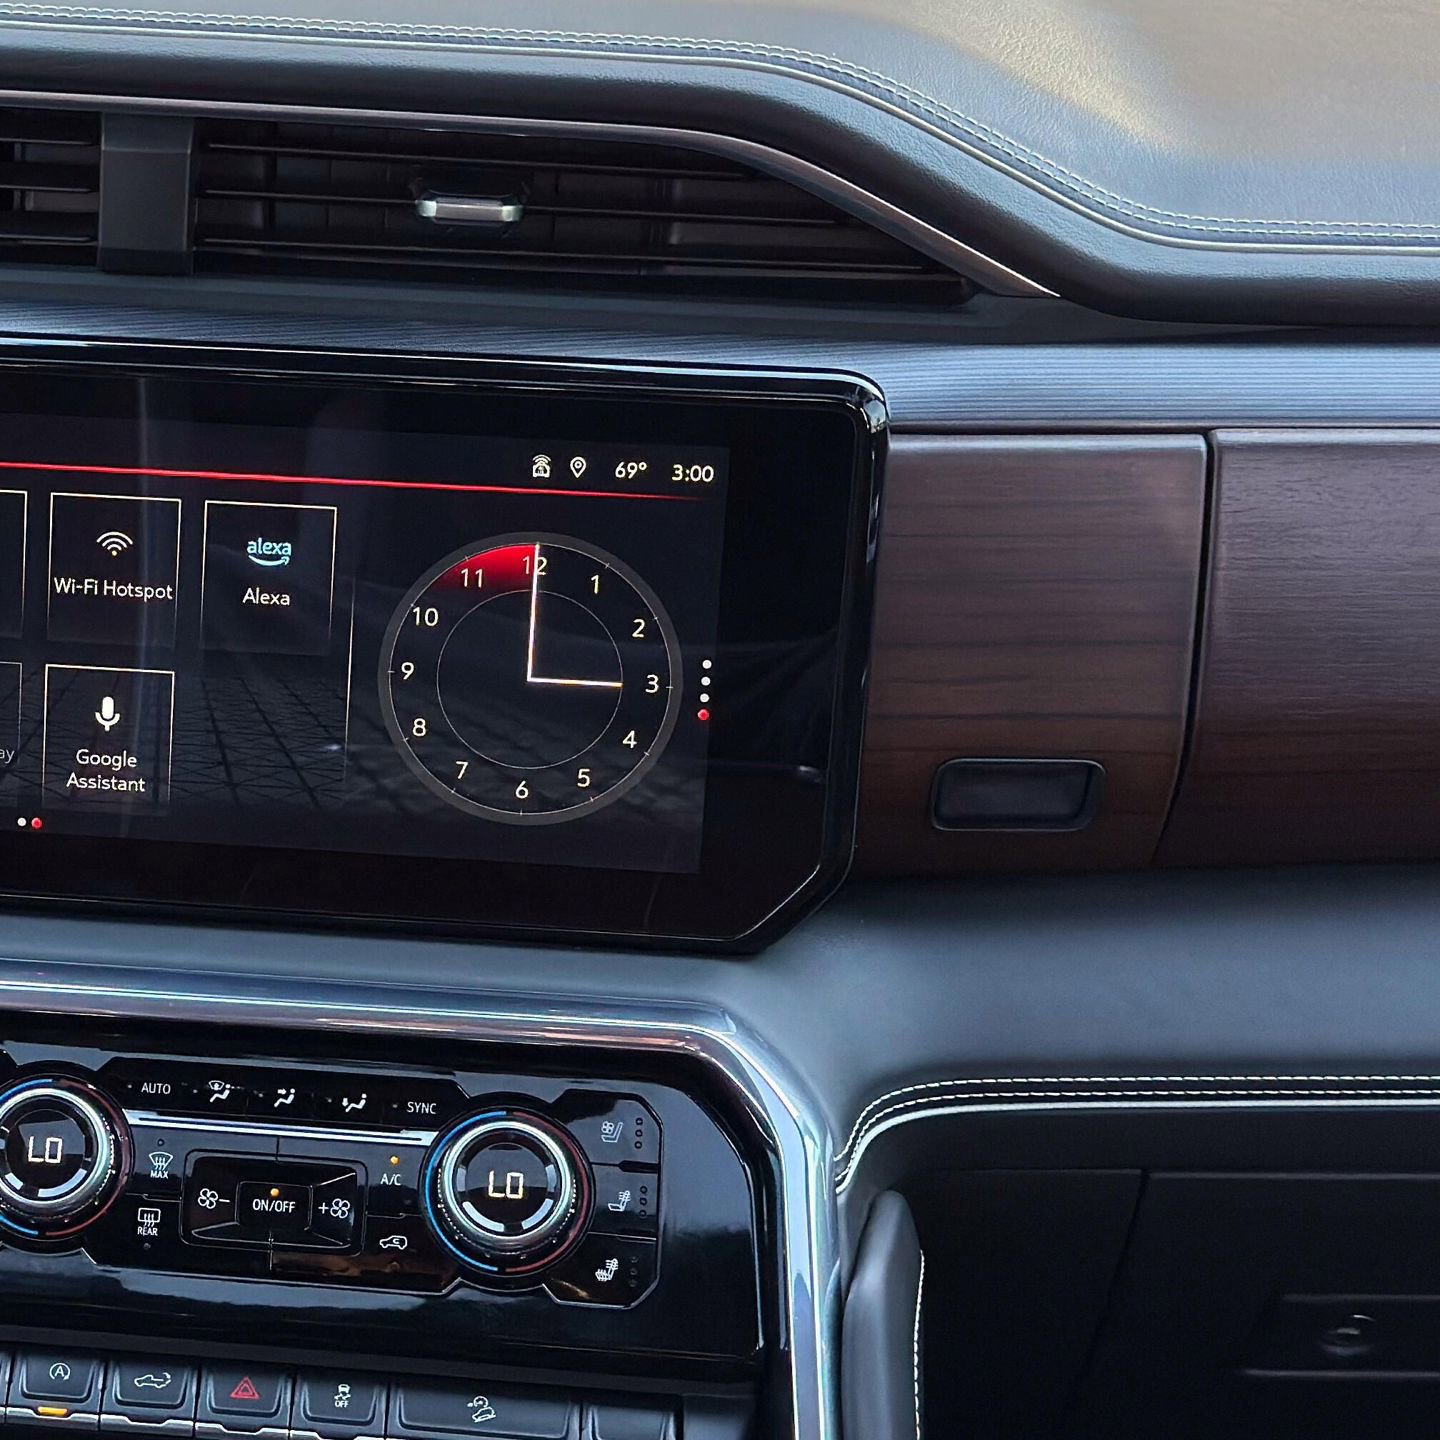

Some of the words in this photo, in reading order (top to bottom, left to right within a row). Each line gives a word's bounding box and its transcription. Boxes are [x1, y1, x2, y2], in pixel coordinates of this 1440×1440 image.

[613, 460, 648, 481] 69°
[671, 463, 715, 484] 3:00
[245, 537, 293, 558] alexa
[521, 555, 548, 577] 12
[459, 568, 485, 589] 11
[589, 574, 602, 595] 1
[53, 576, 100, 598] Wi-Fi
[103, 578, 174, 603] Hotspot
[242, 587, 292, 608] Alexa
[411, 607, 440, 629] 10
[631, 618, 647, 639] 2
[400, 661, 416, 682] 9
[644, 674, 660, 695] 3
[411, 717, 428, 739] 8
[621, 729, 639, 750] 4
[75, 748, 139, 772] Google
[455, 760, 470, 782] 7
[576, 767, 592, 789] 5
[66, 772, 147, 794] Assistant
[515, 779, 531, 801] 6
[140, 1081, 172, 1096] AUTO
[406, 1100, 438, 1116] SYNC
[28, 1135, 63, 1164] LO
[149, 1168, 169, 1180] MAX
[380, 1171, 402, 1187] A/C
[488, 1170, 524, 1200] LO
[252, 1197, 297, 1214] ON/OFF
[136, 1225, 159, 1237] REAR
[334, 1398, 350, 1409] OFF
